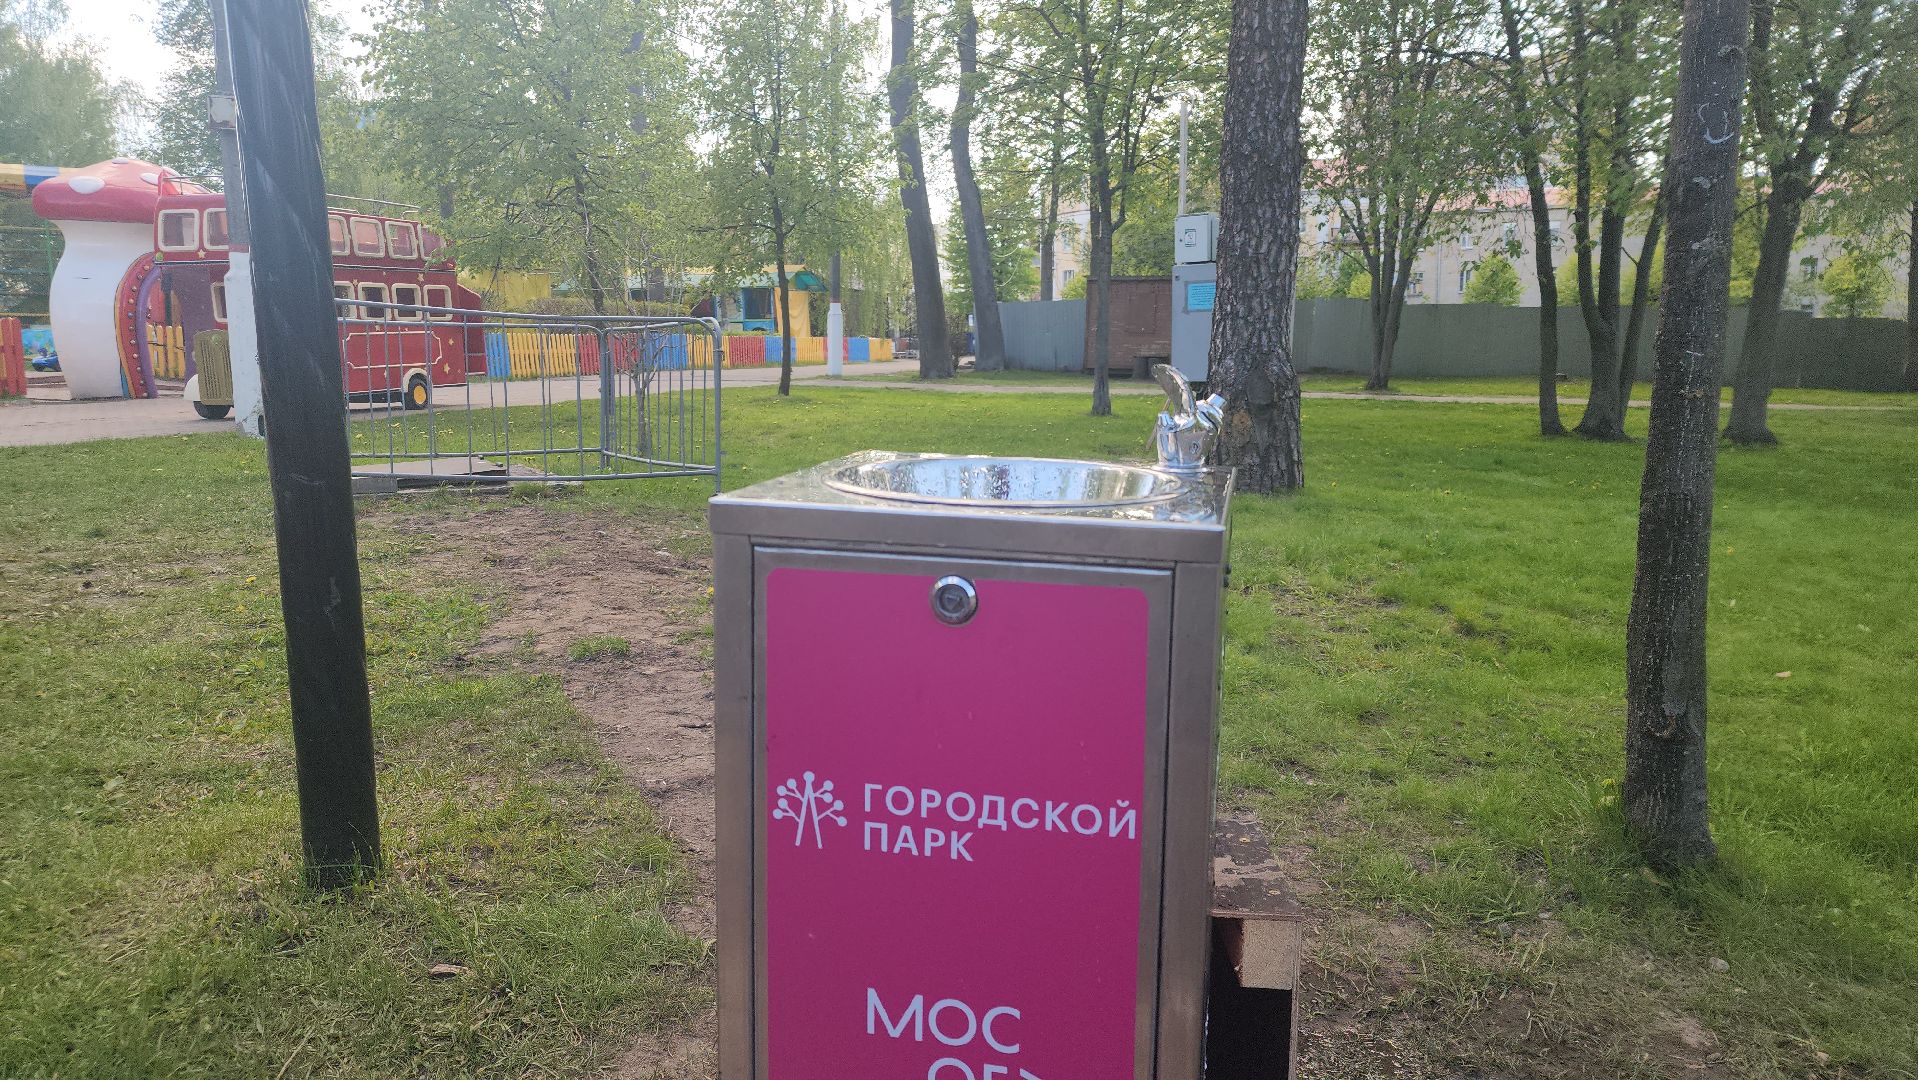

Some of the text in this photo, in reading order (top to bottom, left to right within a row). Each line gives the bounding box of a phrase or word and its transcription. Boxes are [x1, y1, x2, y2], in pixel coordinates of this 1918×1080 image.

[864, 783, 1137, 840] ГОРОДСКОЙ
[864, 821, 974, 862] ПАРК
[866, 987, 1021, 1054] МОС
